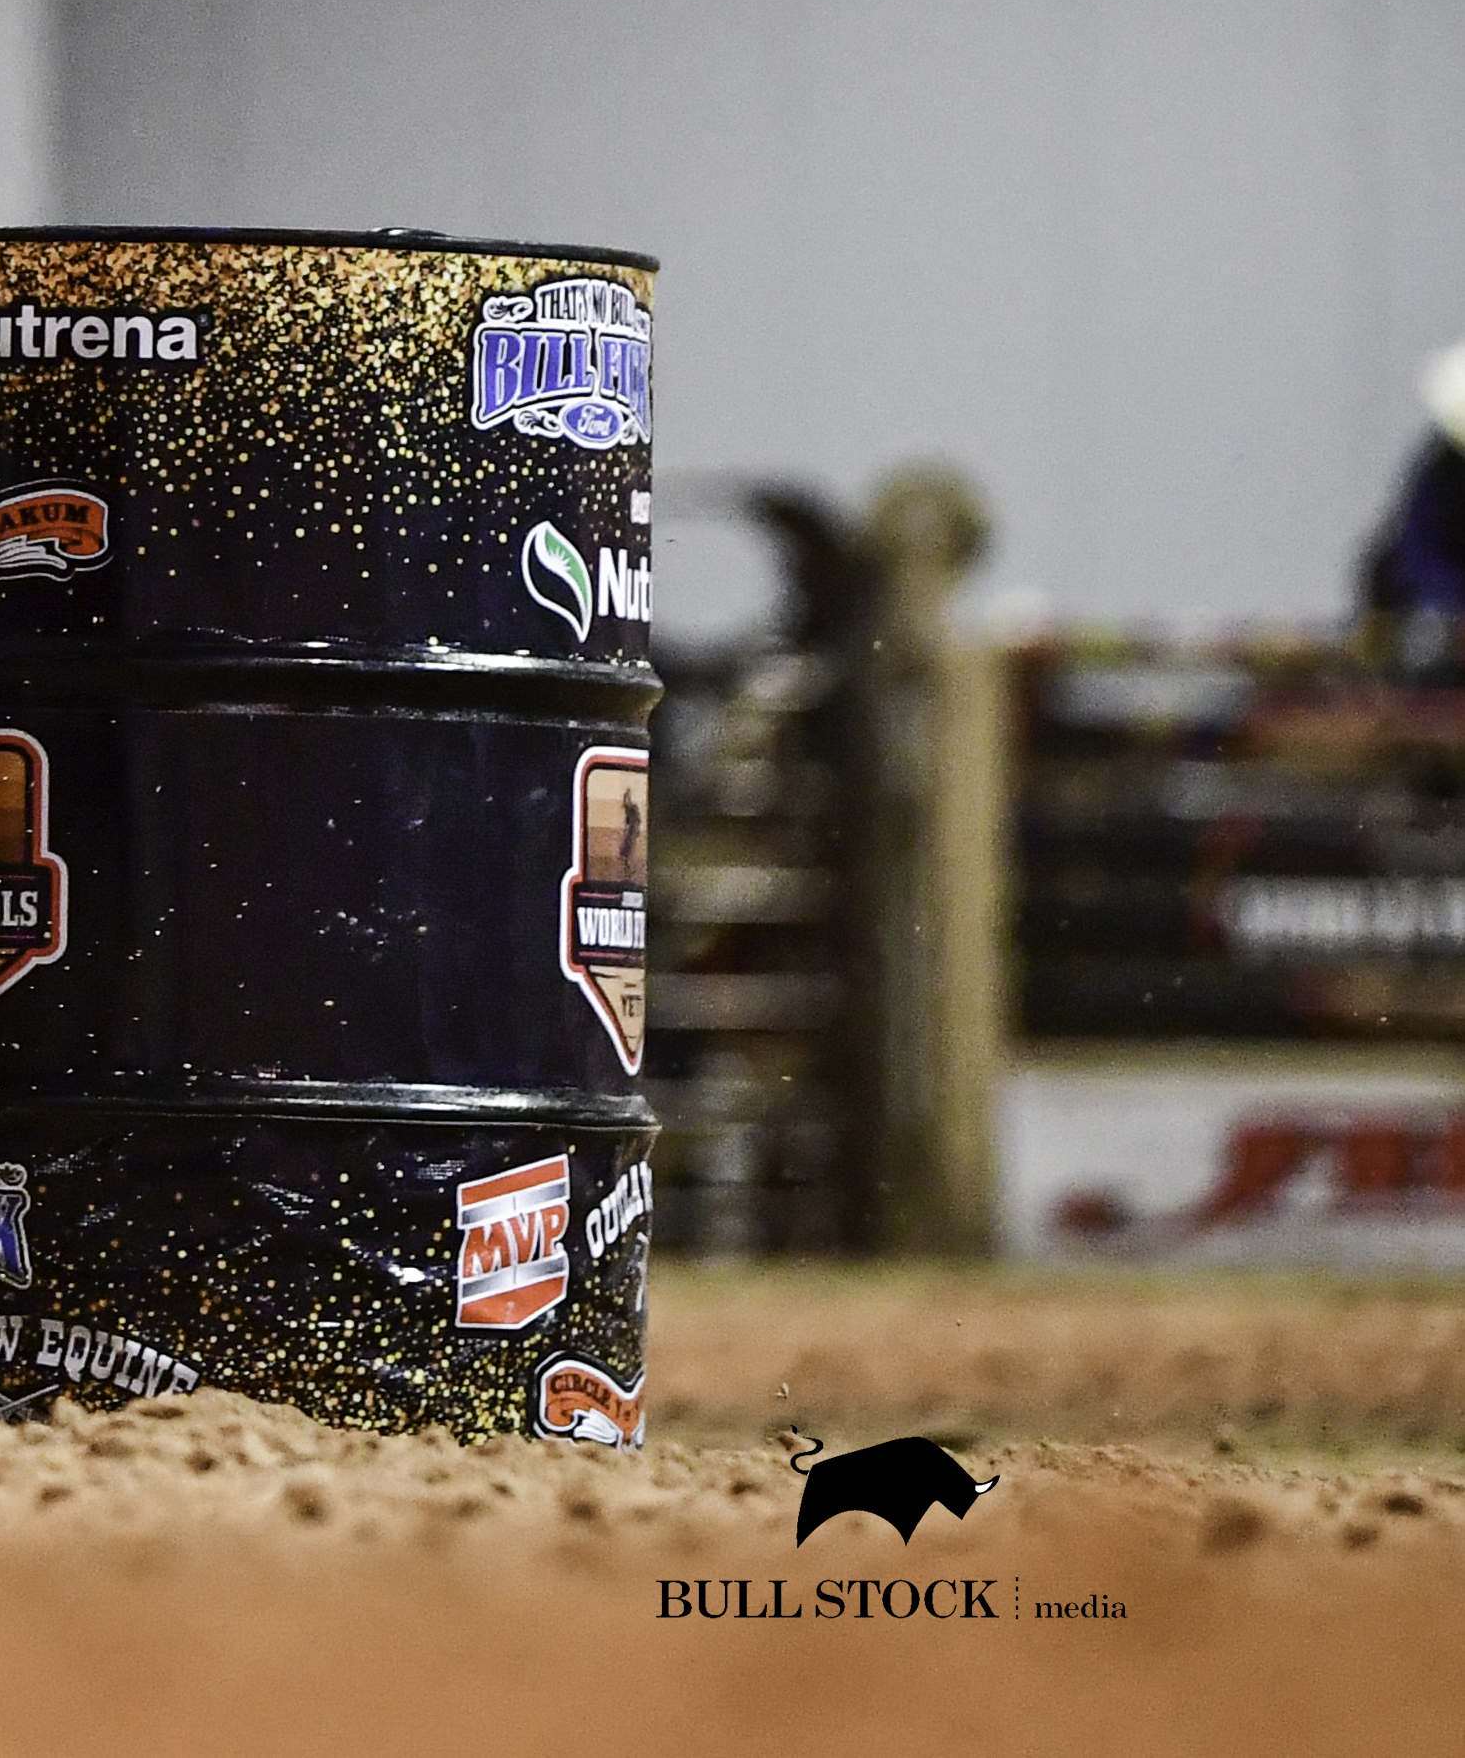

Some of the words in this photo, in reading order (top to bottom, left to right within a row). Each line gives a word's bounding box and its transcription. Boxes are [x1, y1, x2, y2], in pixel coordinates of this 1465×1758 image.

[481, 330, 597, 421] BILL
[578, 404, 613, 437] Ford
[463, 1203, 566, 1278] MVP
[550, 1373, 611, 1410] CIRCLE
